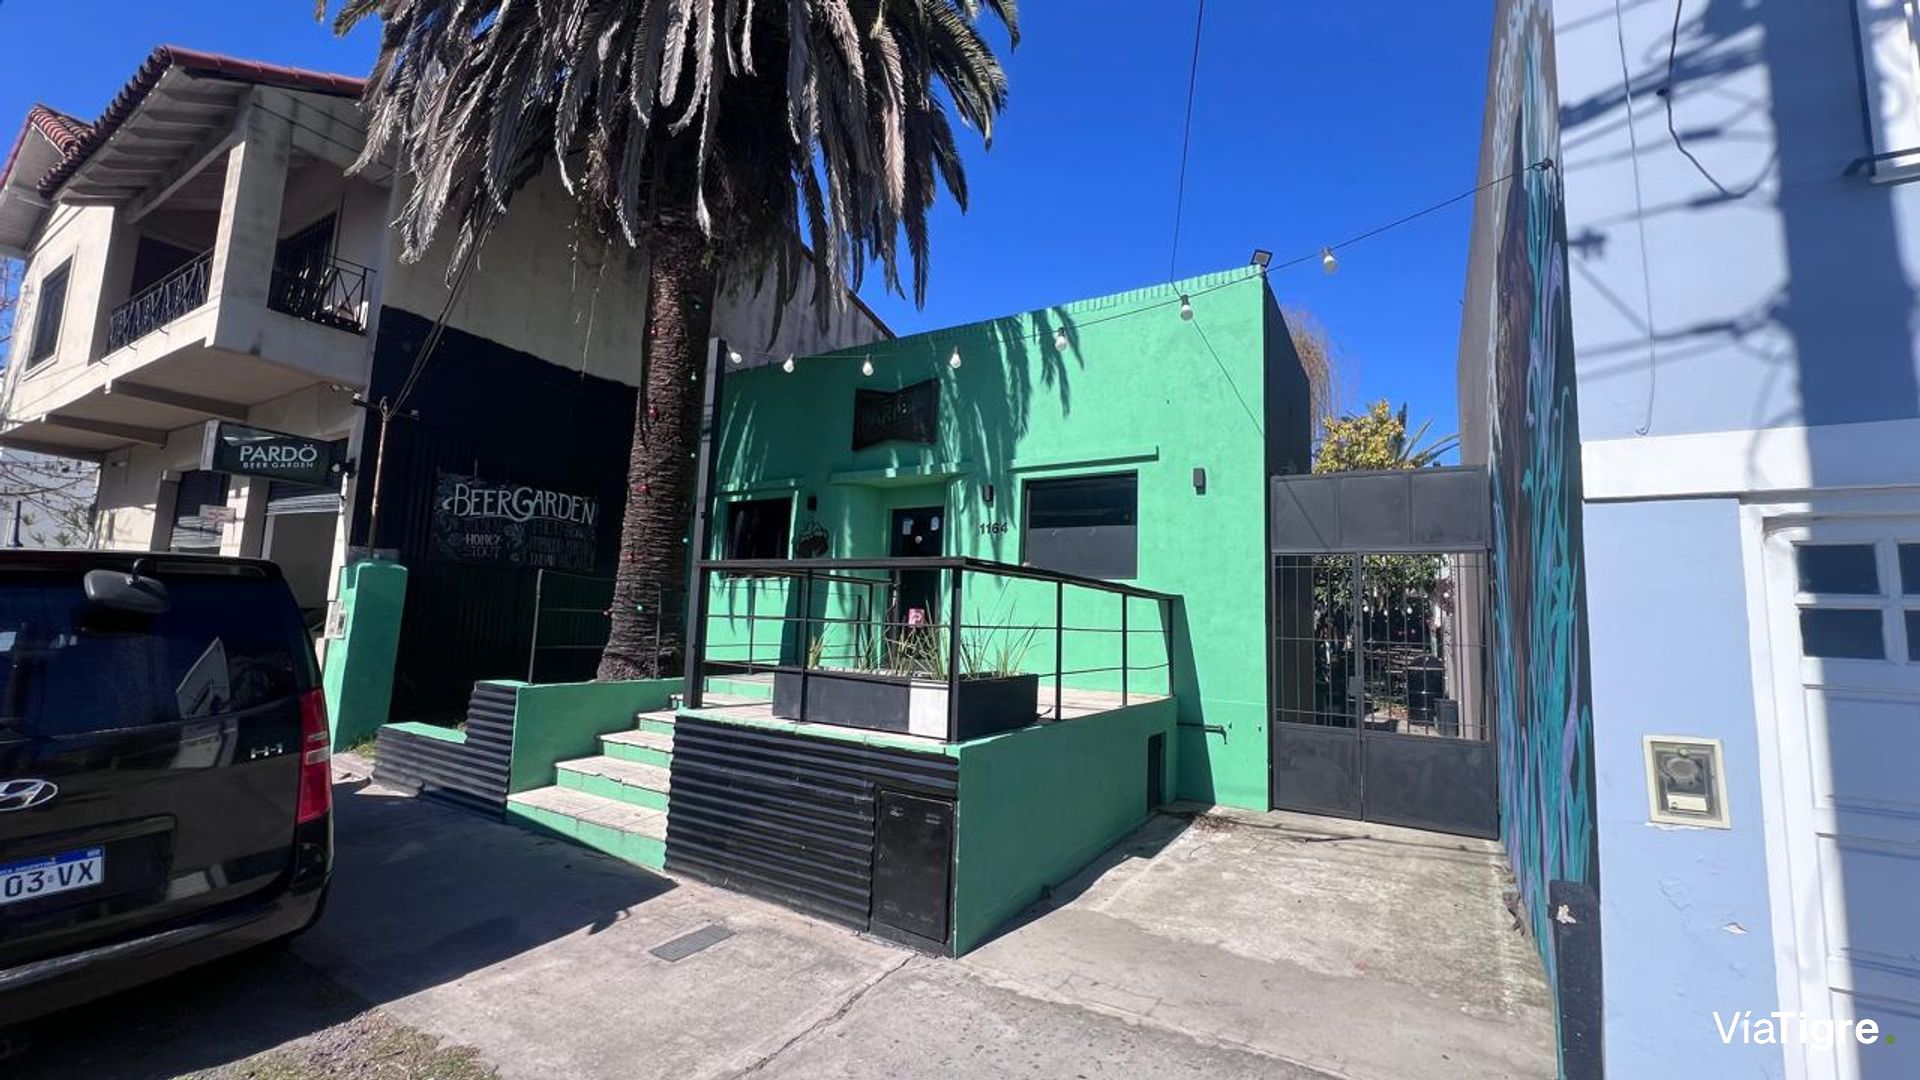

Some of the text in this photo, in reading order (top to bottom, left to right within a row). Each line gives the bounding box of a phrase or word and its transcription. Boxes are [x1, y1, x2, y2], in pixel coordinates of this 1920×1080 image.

[240, 444, 318, 462] PARDÖ
[242, 461, 314, 469] BEER GARDEN
[979, 521, 1008, 535] 1164
